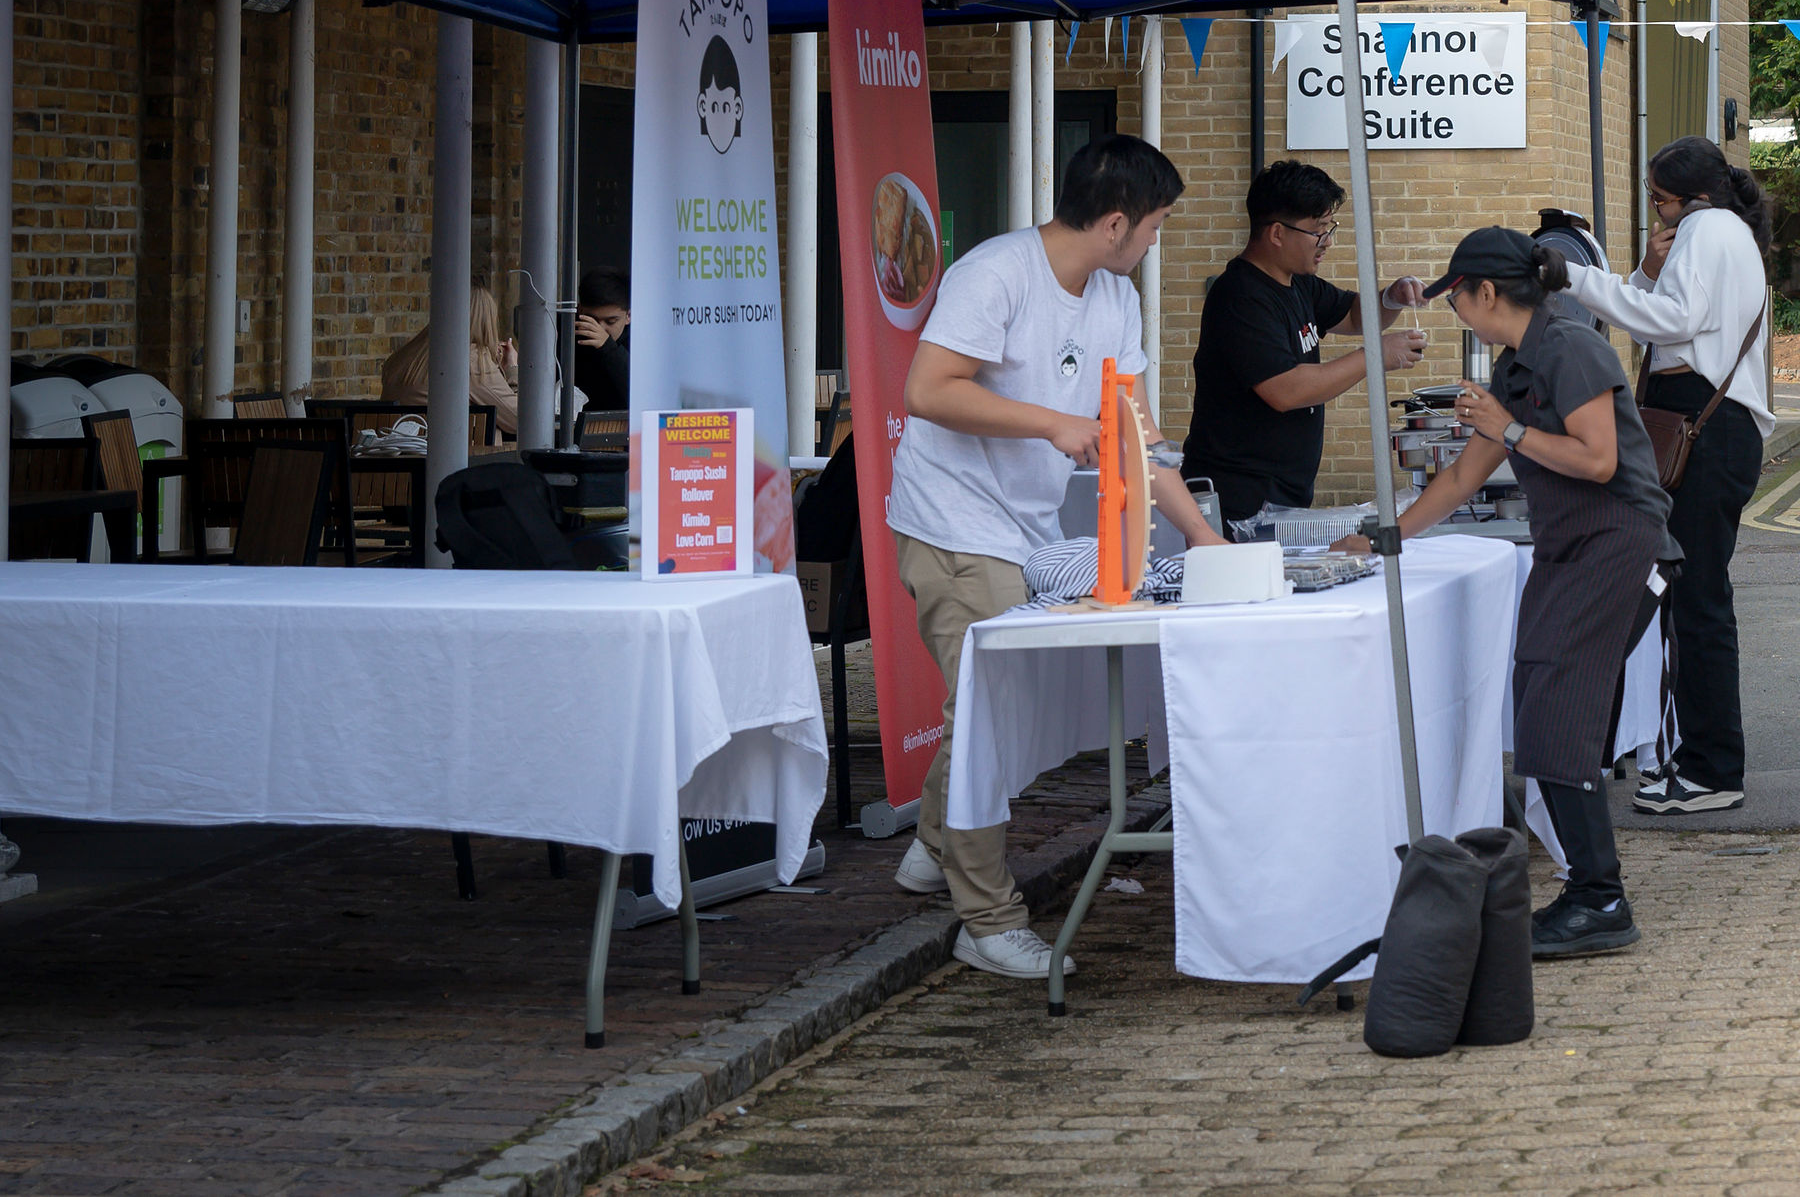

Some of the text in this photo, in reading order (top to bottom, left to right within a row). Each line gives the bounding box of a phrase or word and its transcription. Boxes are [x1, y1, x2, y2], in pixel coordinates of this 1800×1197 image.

[855, 28, 922, 88] kimiko
[1363, 109, 1454, 139] Suite
[676, 198, 768, 232] WELCOME
[678, 245, 767, 279] FRESHERS
[672, 304, 776, 325] TRY OUR SUSHI TODAY!
[666, 415, 729, 428] FRESHERS
[887, 411, 902, 439] the
[666, 429, 730, 441] WELCOME
[670, 465, 726, 483] Tanpopo Sushi
[681, 488, 714, 502] Rollover
[682, 512, 710, 527] Kimiko
[676, 532, 714, 547] Love Corn
